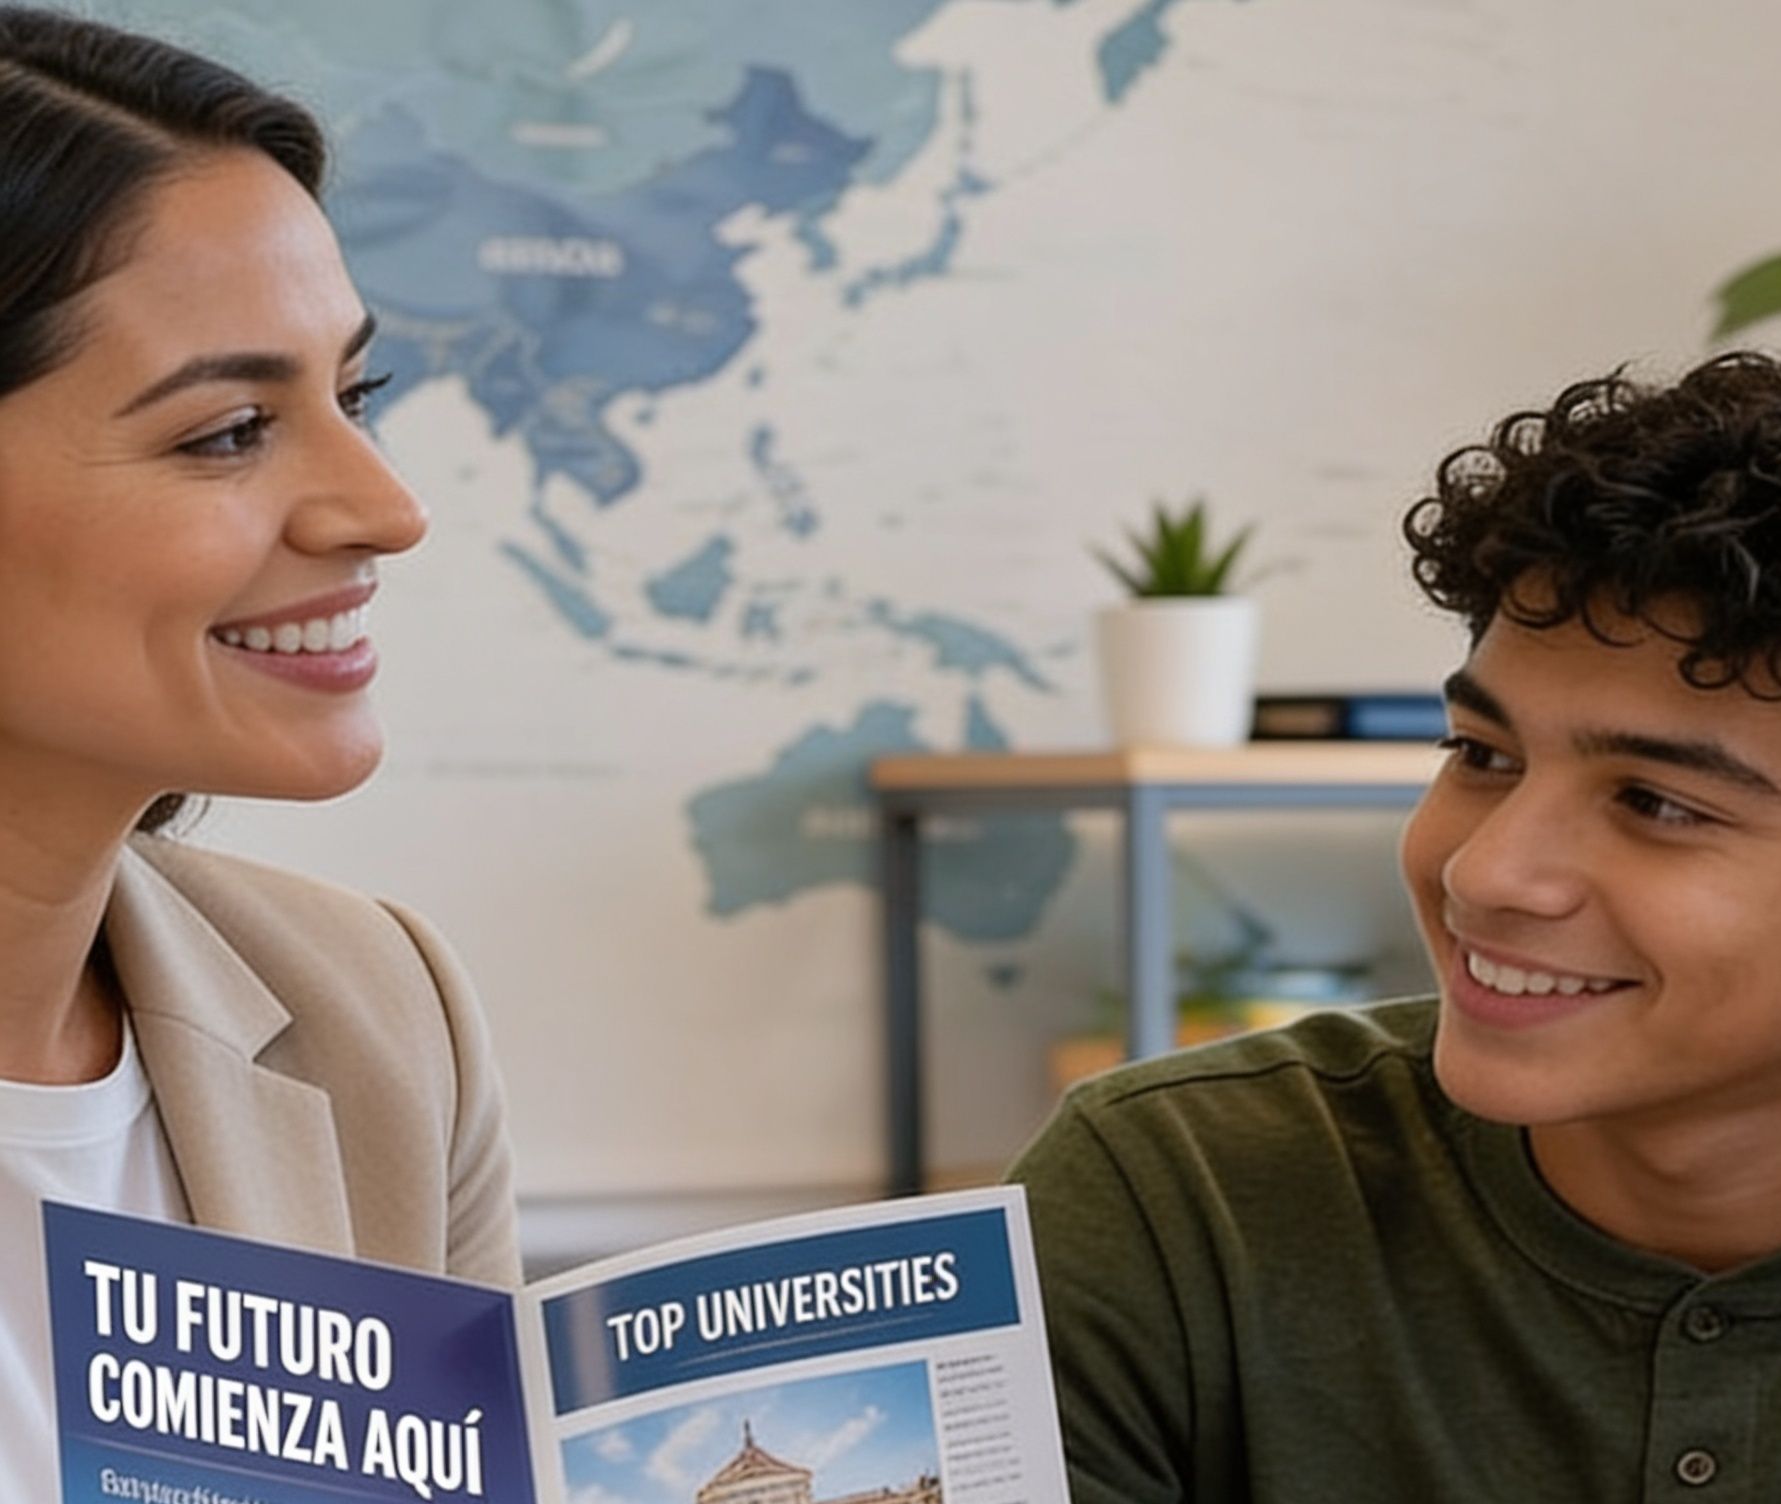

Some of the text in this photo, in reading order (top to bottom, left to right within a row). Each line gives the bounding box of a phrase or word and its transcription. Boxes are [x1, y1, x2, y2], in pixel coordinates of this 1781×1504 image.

[84, 1260, 392, 1390] TU FUTURO
[606, 1252, 959, 1361] TOP UNIVERSITIES
[88, 1353, 349, 1471] COMIENZA
[362, 1408, 483, 1500] AQUÍ
